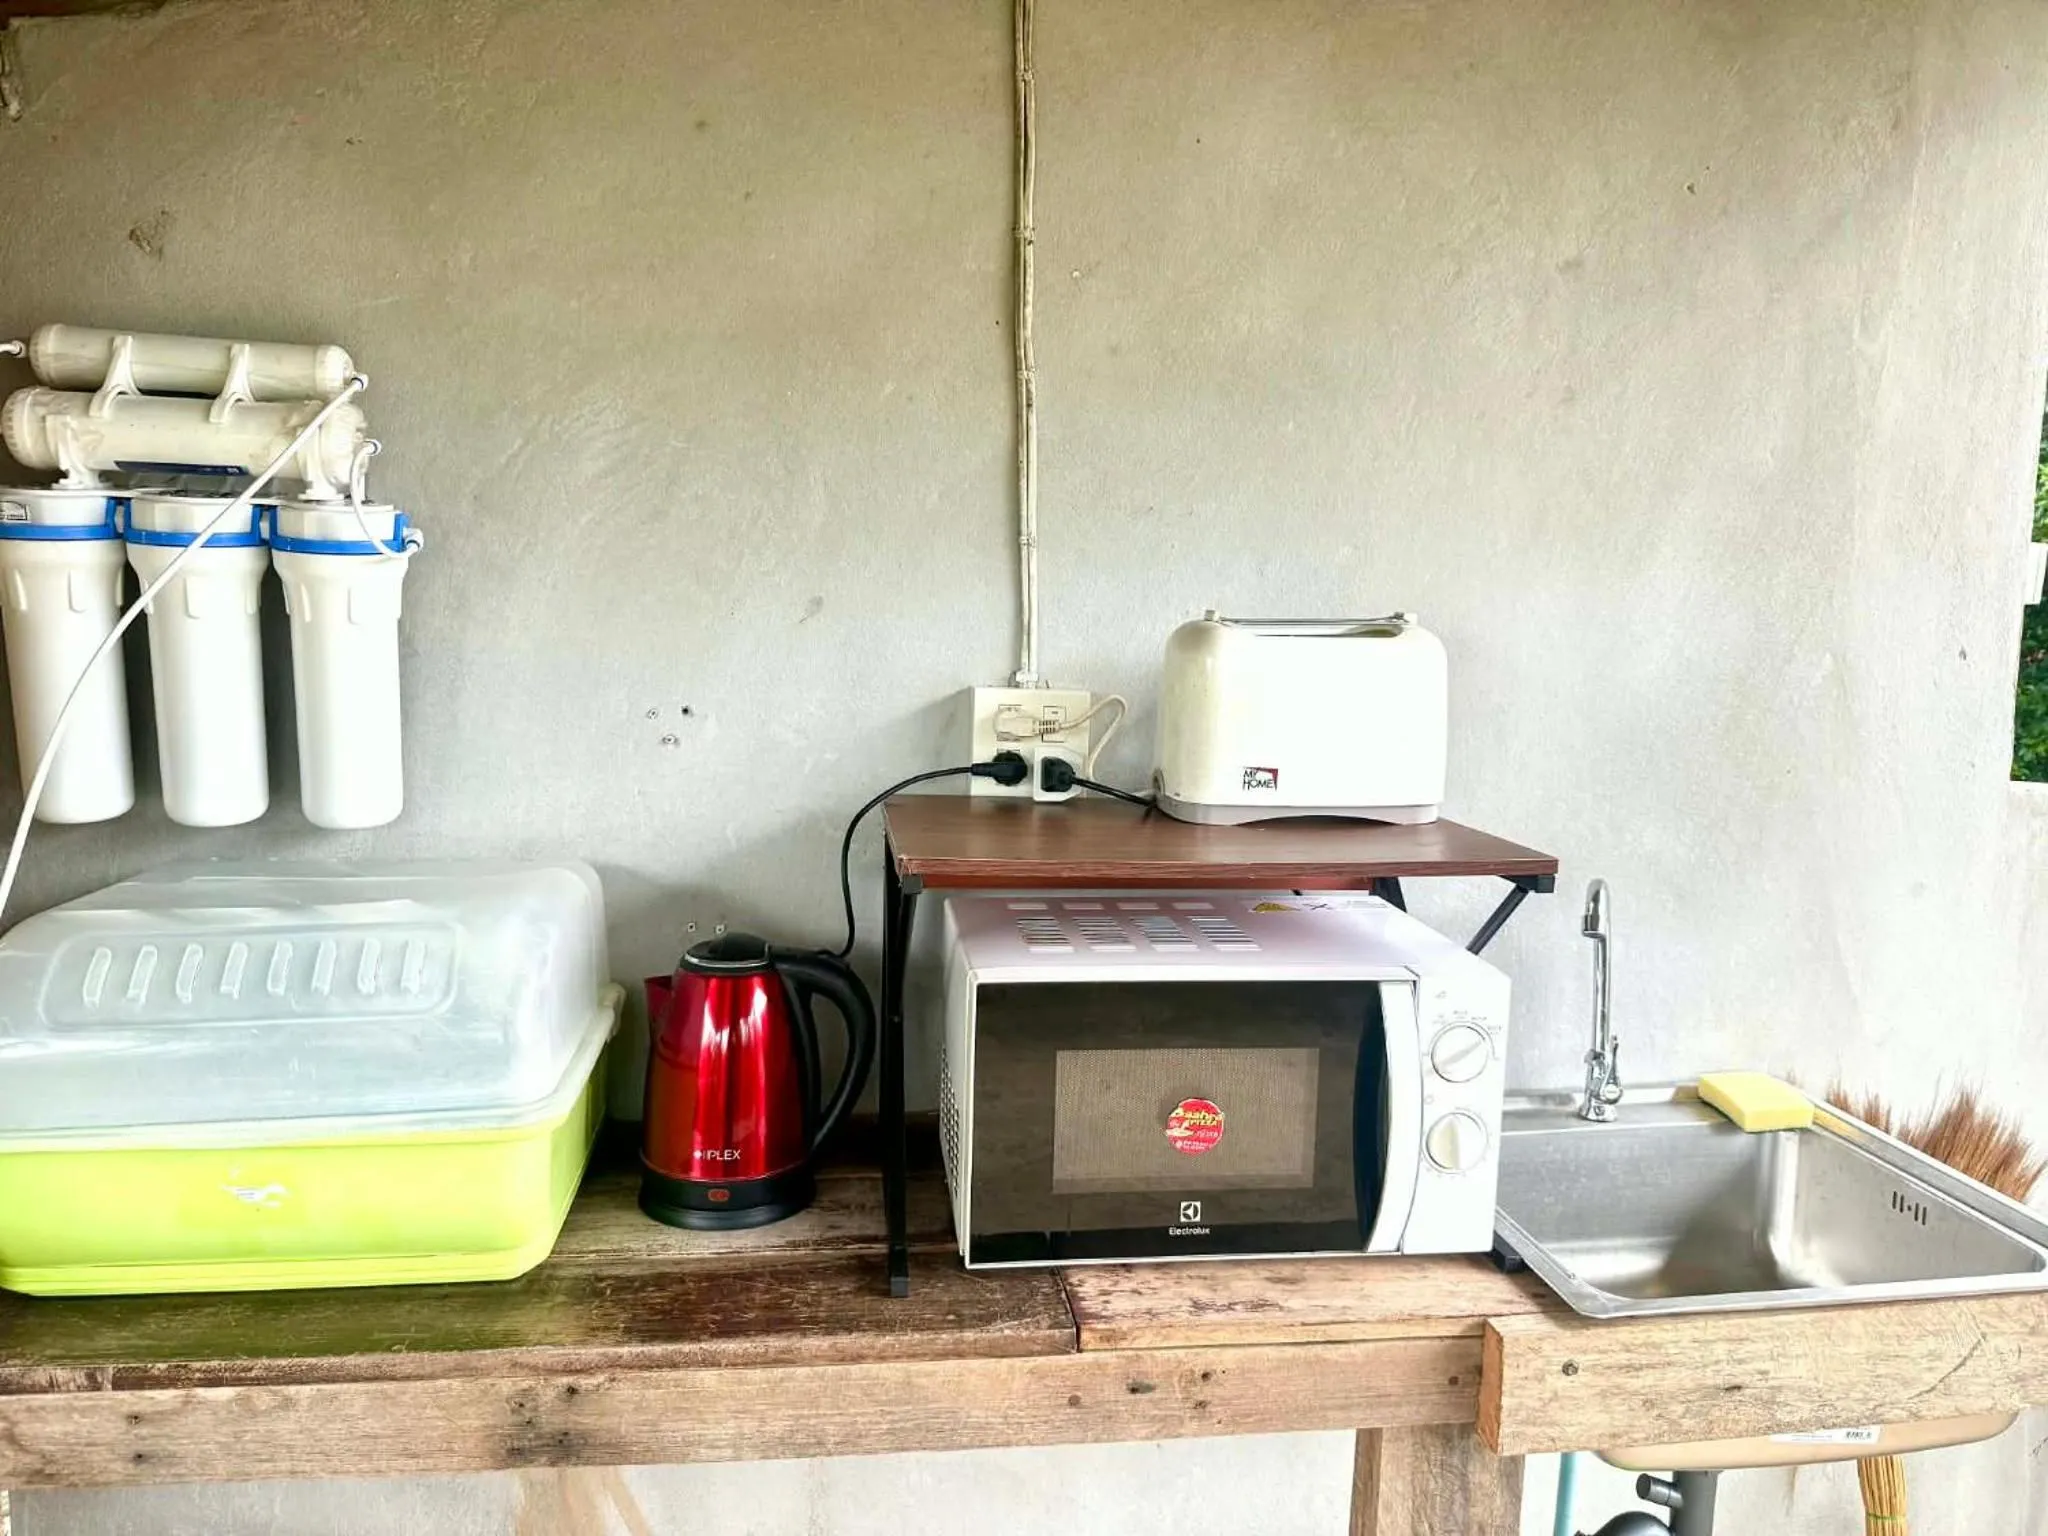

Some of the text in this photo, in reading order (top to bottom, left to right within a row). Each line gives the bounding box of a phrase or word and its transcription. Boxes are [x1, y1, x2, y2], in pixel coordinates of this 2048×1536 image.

[1243, 768, 1259, 778] MY
[1242, 778, 1273, 790] HOME
[1169, 1226, 1210, 1236] Electrolux
